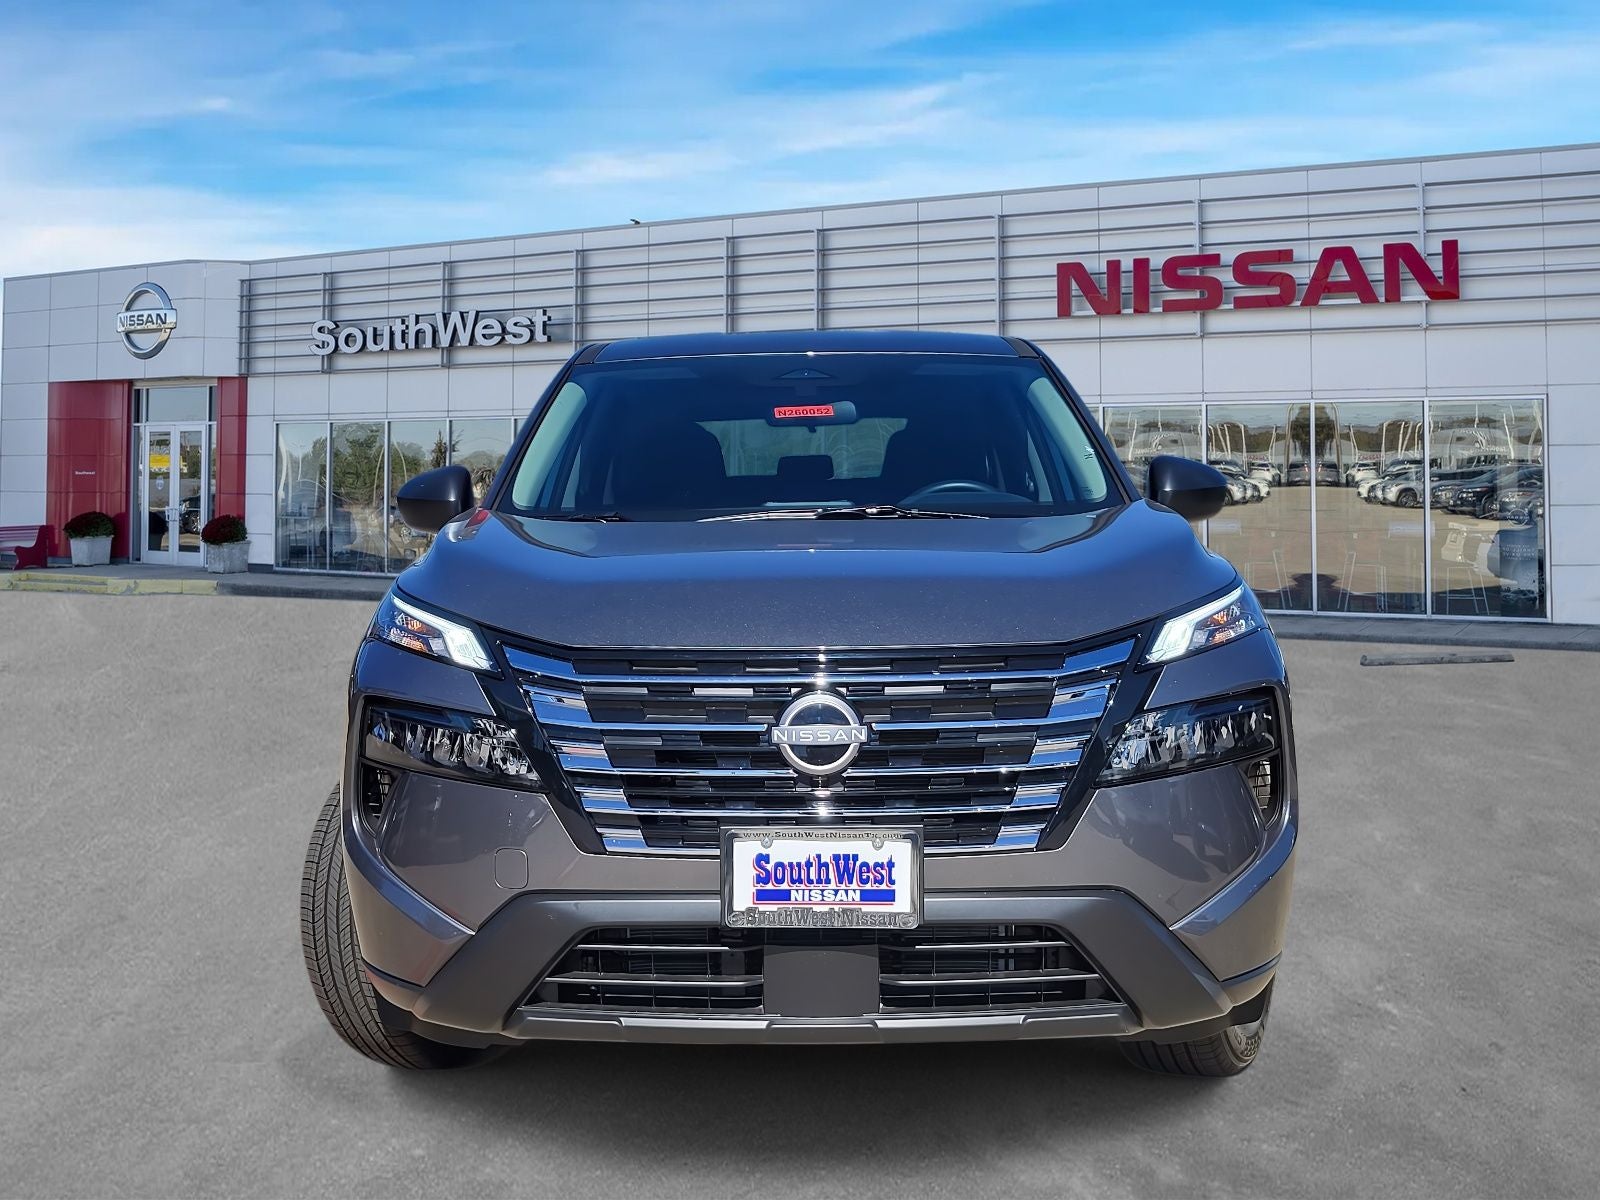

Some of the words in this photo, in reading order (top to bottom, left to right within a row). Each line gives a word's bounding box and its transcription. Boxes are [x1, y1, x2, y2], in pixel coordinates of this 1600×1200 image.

[1056, 239, 1460, 317] NISSAN
[118, 313, 167, 328] NISSAN
[308, 309, 551, 355] SouthWest
[777, 408, 830, 417] N260052
[773, 728, 866, 742] NISSAN
[753, 853, 896, 887] SouthWest
[790, 889, 861, 902] NISSAN
